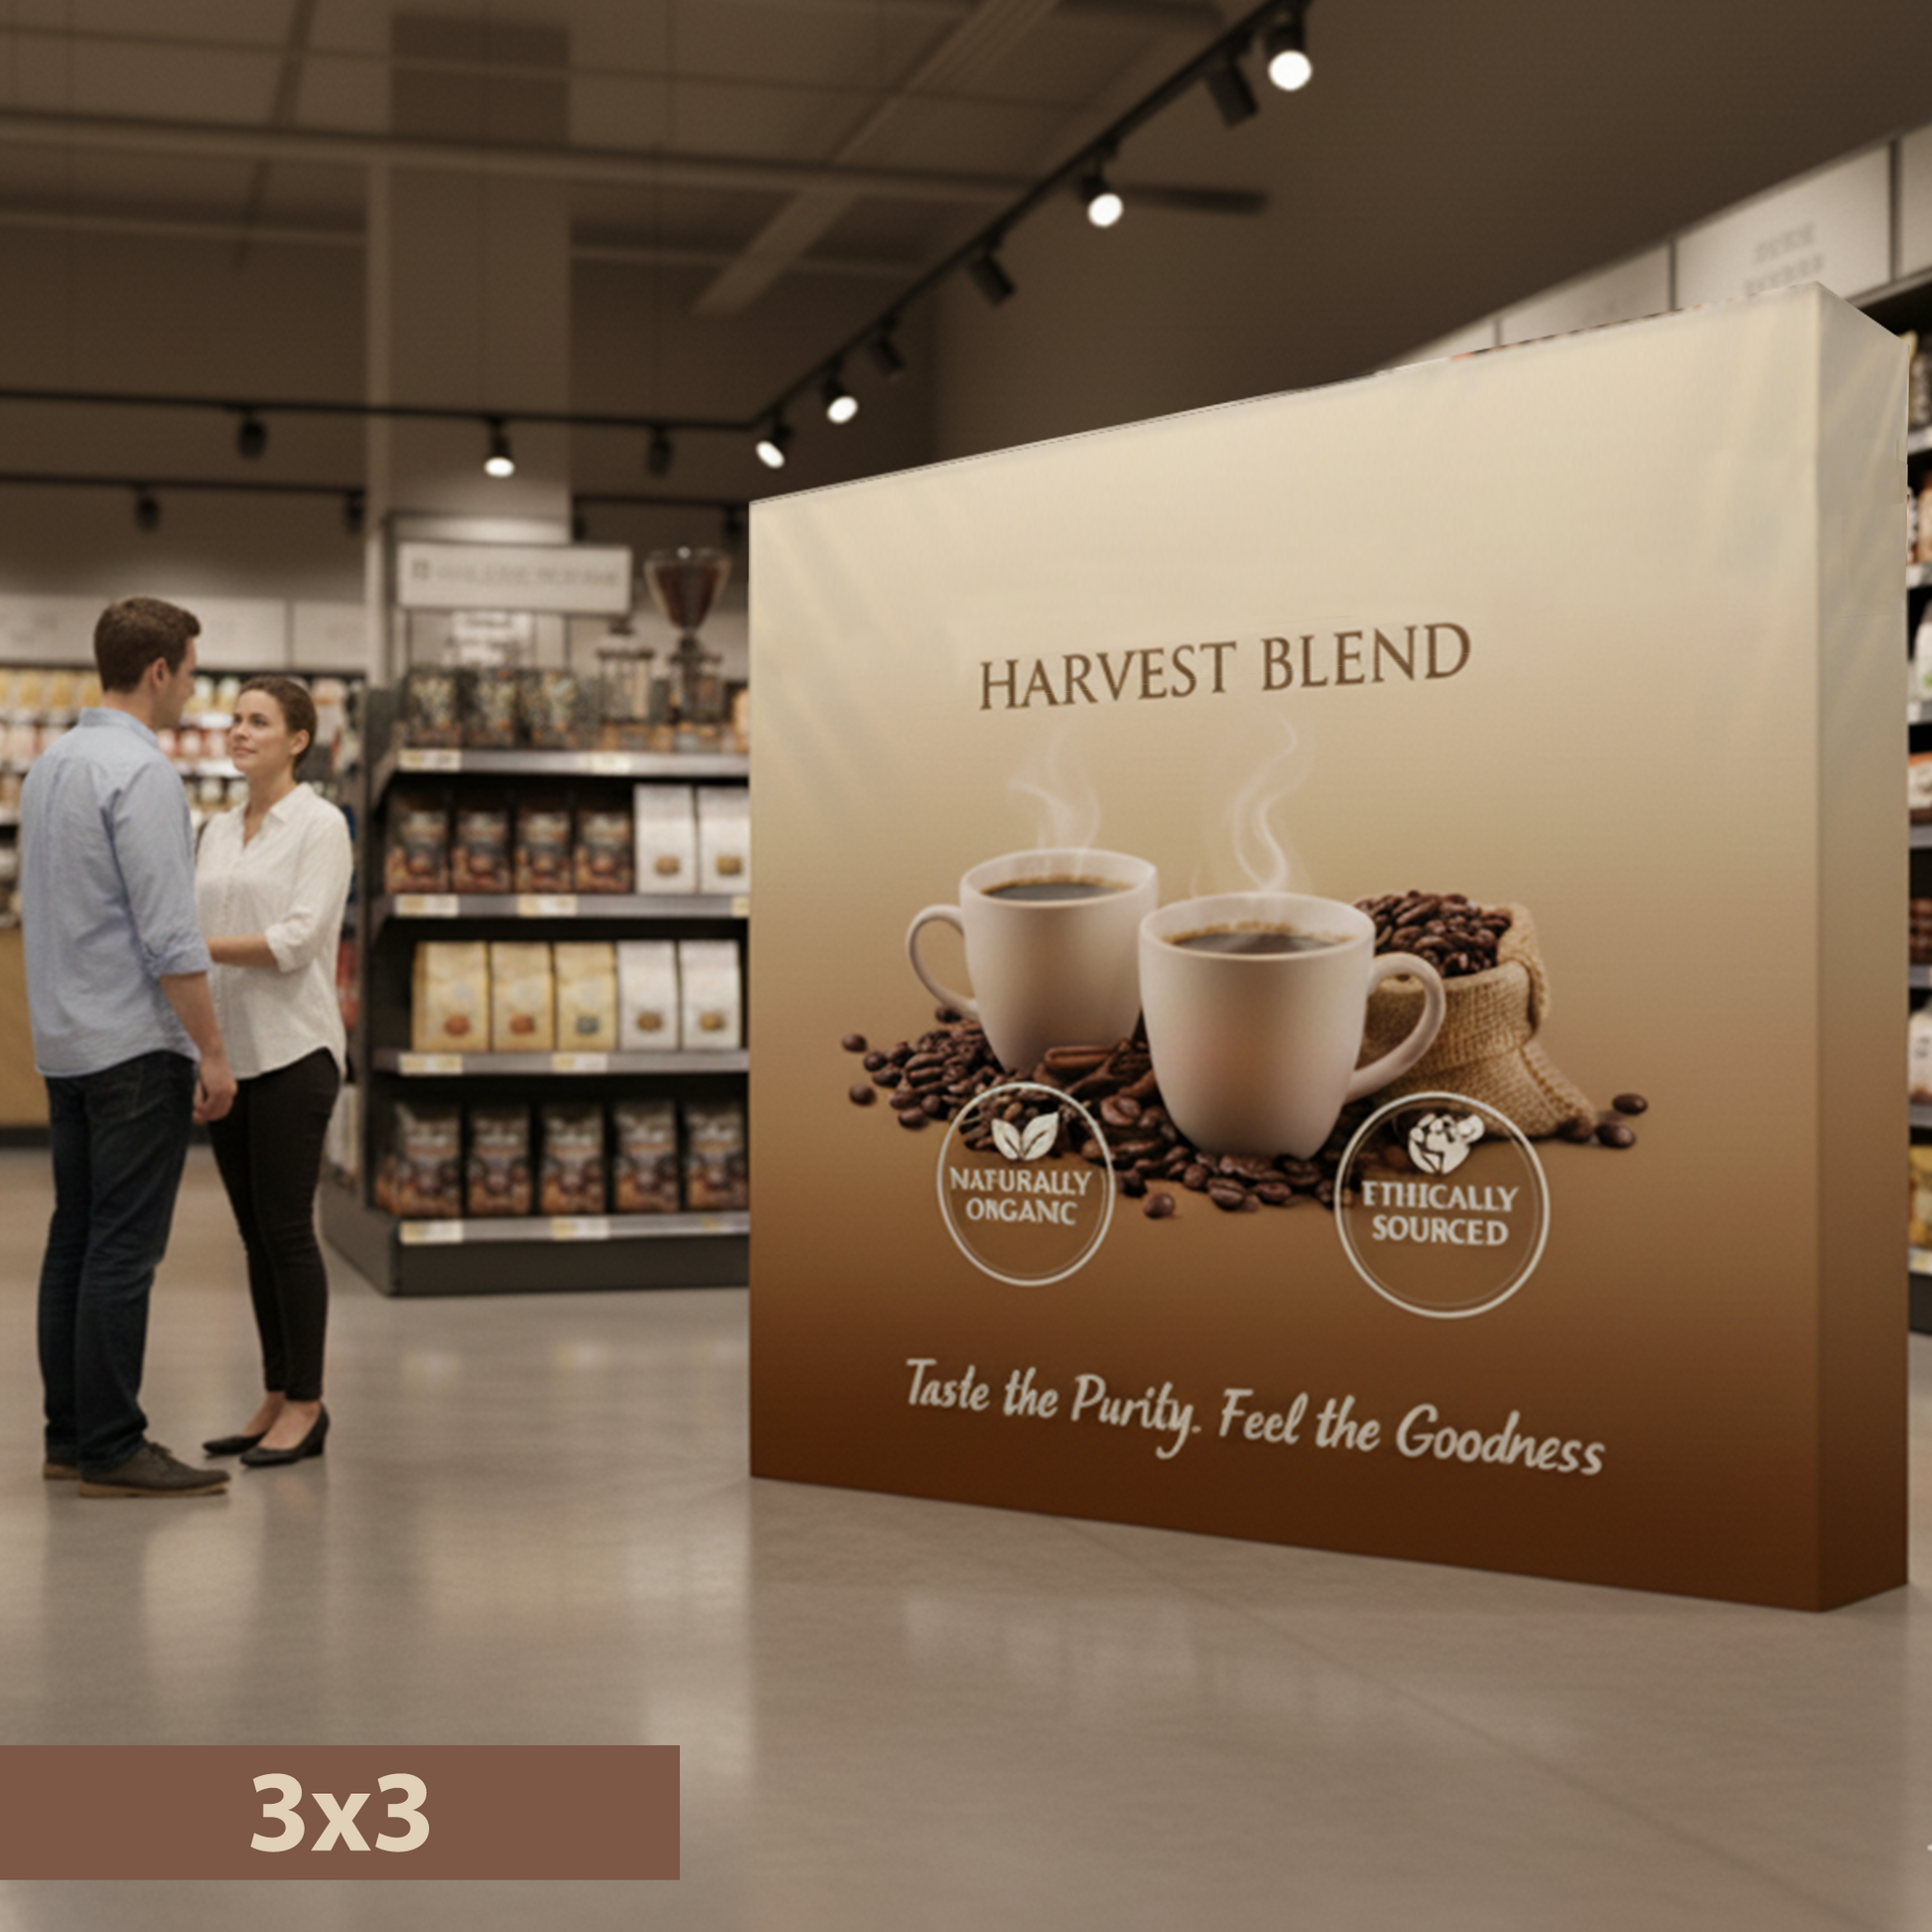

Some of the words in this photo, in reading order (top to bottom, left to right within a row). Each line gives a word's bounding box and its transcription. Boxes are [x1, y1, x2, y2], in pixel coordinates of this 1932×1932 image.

[980, 640, 1237, 711] HARVEST
[1260, 621, 1472, 692] BLEND
[949, 1166, 1092, 1196] NATURALLY
[1361, 1180, 1520, 1213] ETHICALLY
[1372, 1214, 1509, 1246] SOURCED
[905, 1358, 990, 1411] Taste
[1003, 1366, 1058, 1418] the
[1070, 1373, 1202, 1459] Purity.
[1218, 1388, 1310, 1445] Feel
[1314, 1395, 1381, 1452] the
[1395, 1403, 1606, 1476] Goodness
